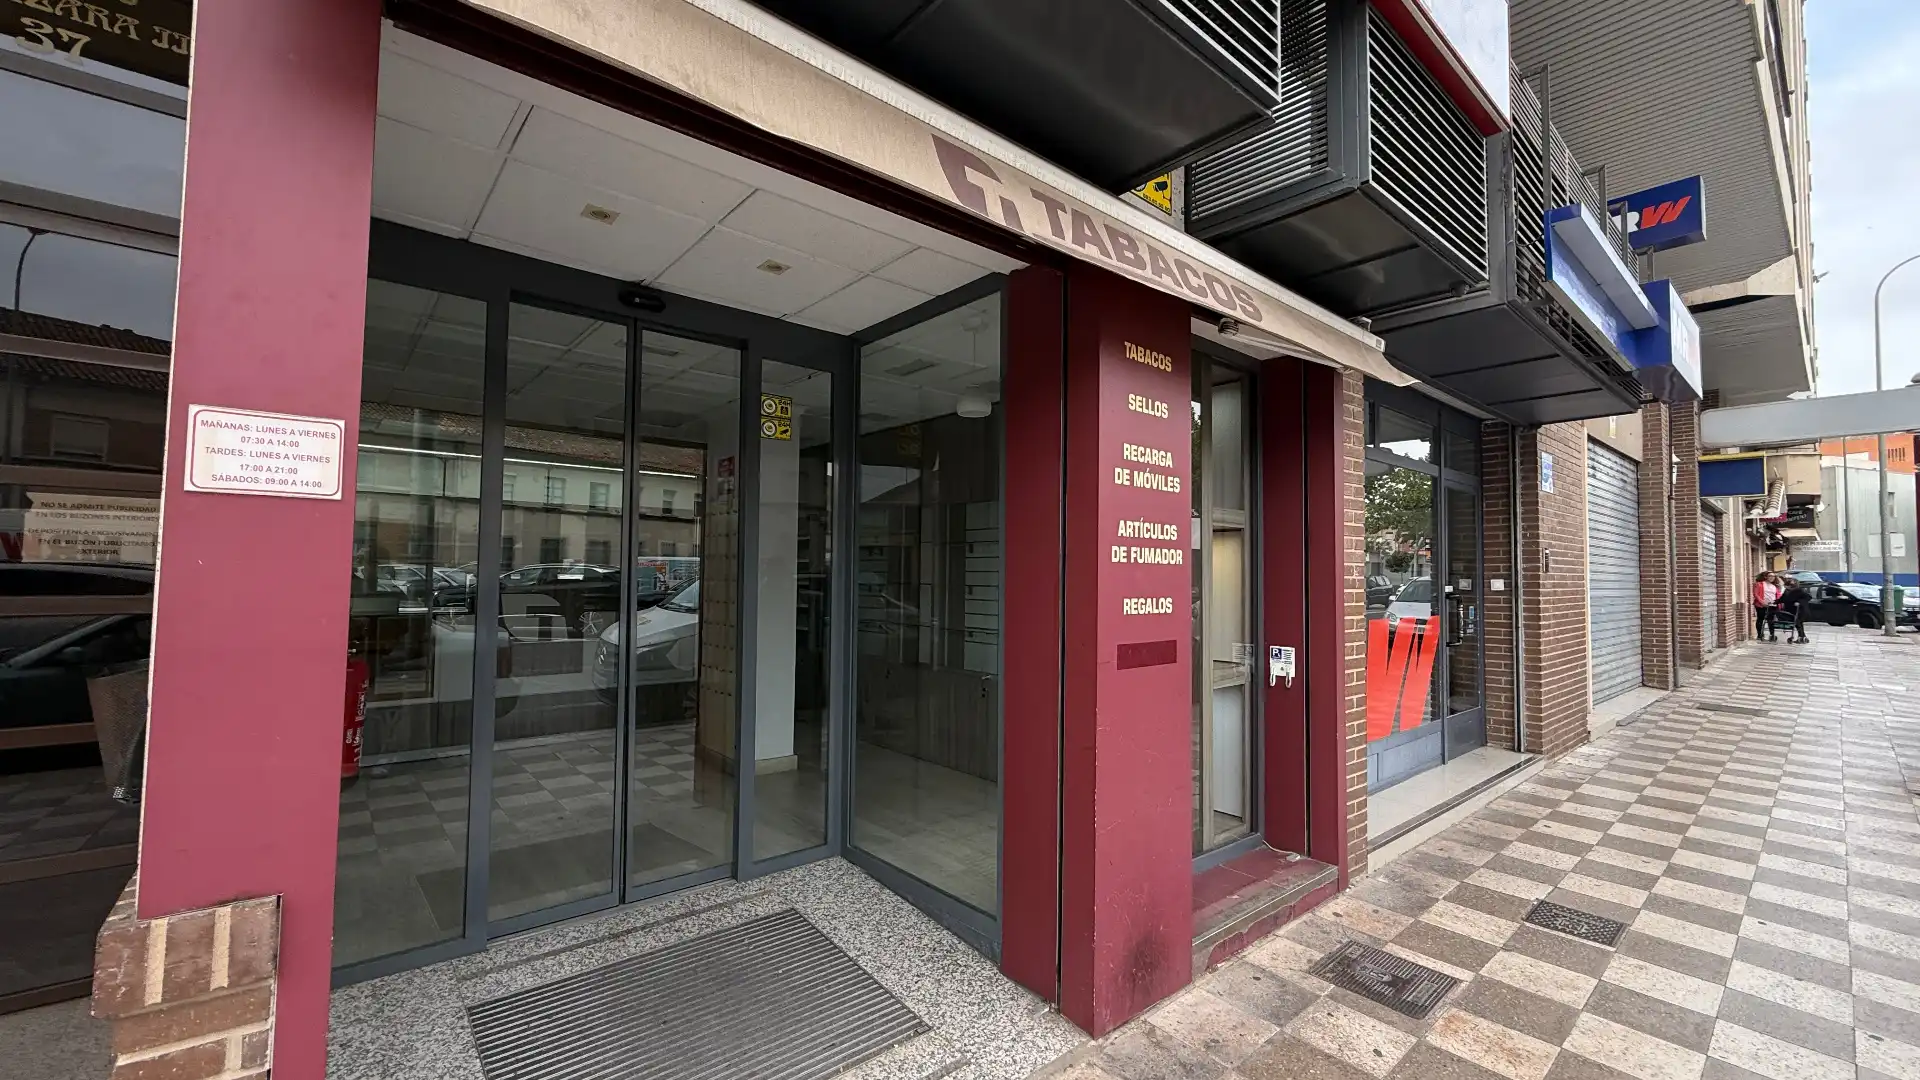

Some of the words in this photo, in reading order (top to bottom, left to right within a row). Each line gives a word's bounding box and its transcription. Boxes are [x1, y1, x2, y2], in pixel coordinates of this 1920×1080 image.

[15, 16, 91, 66] 37
[1612, 196, 1692, 233] RW
[1030, 187, 1263, 322] TABACOS
[1125, 341, 1172, 372] TABACOS
[1128, 393, 1169, 419] SELLOS
[201, 419, 253, 432] MAÑANAS:
[256, 425, 287, 435] LUNES
[298, 429, 336, 440] VIERNES
[240, 436, 265, 445] 07:30
[267, 438, 274, 446] A
[277, 439, 300, 448] 14:00
[205, 446, 247, 457] TARDES:
[249, 450, 281, 460] LUNES
[292, 454, 331, 464] VIERNES
[1123, 443, 1173, 468] RECARGA
[240, 463, 263, 472] 17:00
[274, 466, 298, 475] 21:00
[1114, 467, 1130, 486] DE
[1133, 468, 1180, 493] MÓVILES
[265, 477, 289, 486] 09:00
[291, 479, 297, 487] A
[300, 480, 322, 488] 14:00
[1118, 517, 1178, 541] ARTÍCULOS
[1111, 546, 1127, 562] DE
[1131, 547, 1182, 564] FUMADOR
[1123, 598, 1173, 615] REGALOS
